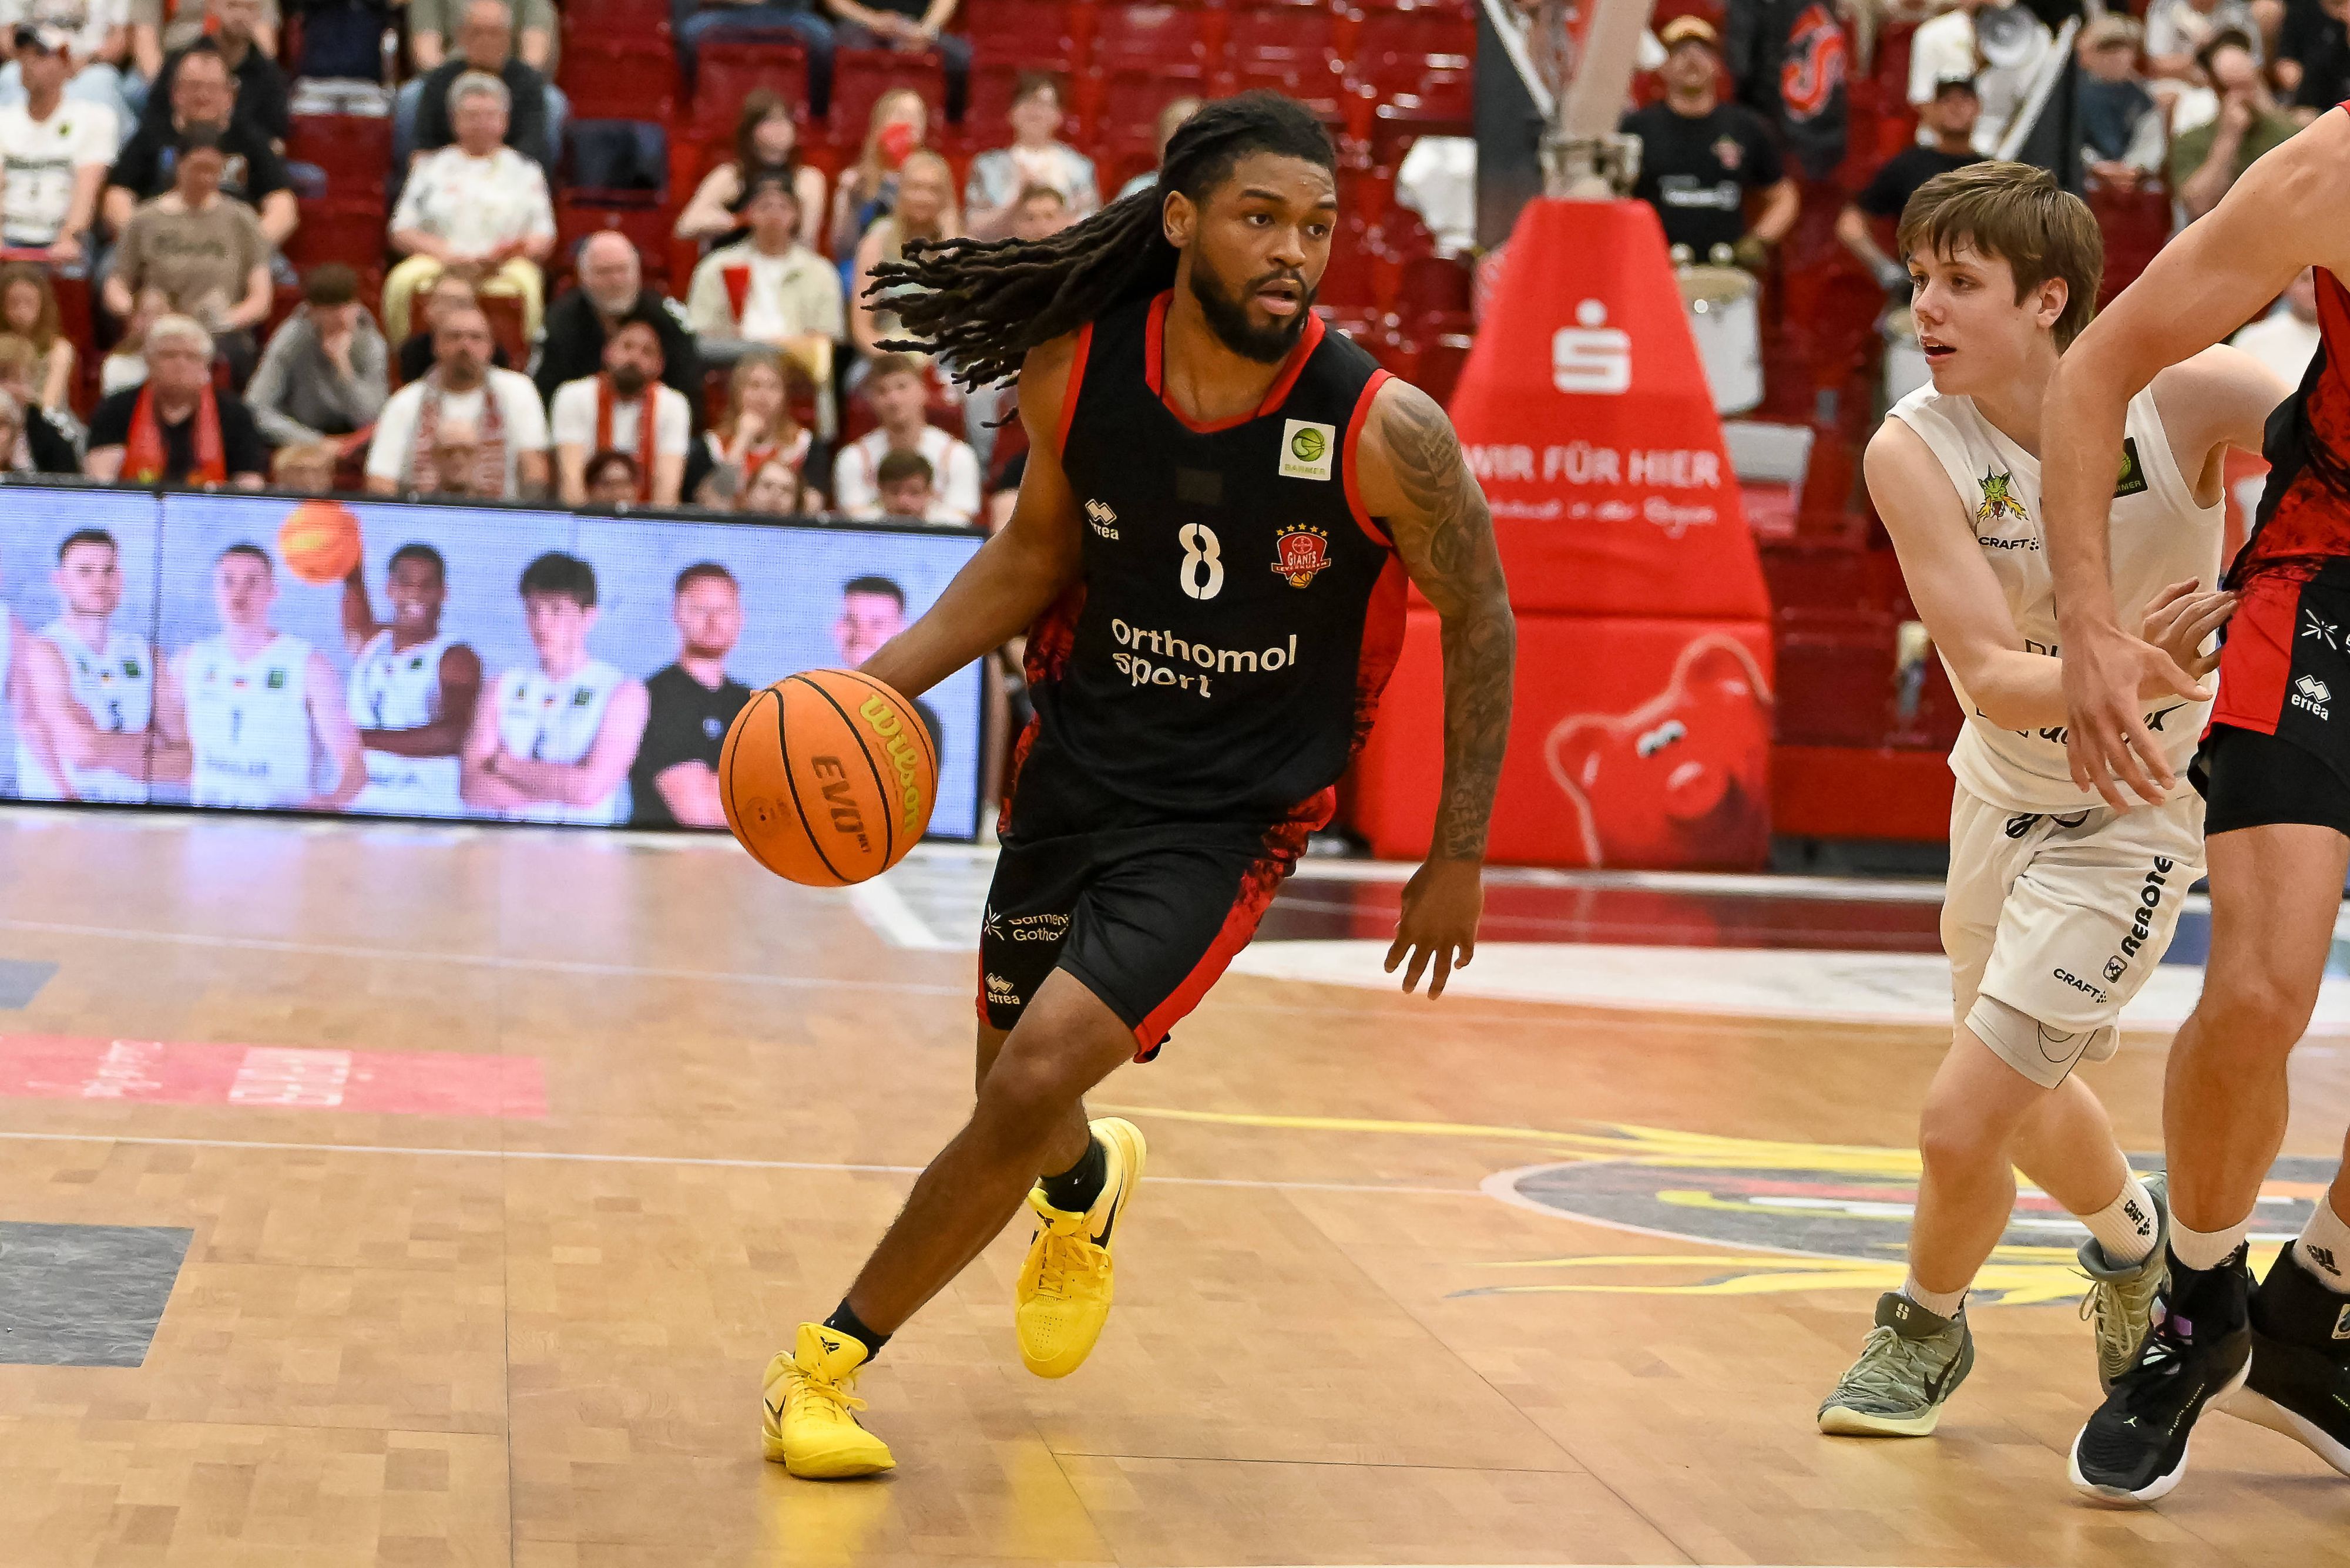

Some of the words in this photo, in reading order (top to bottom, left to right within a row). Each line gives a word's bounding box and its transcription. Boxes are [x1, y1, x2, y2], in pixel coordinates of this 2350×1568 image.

[1284, 464, 1325, 475] BARMER
[1543, 439, 1622, 485] FÜR
[1628, 448, 1720, 489] HIER
[1179, 523, 1224, 600] 8
[1287, 550, 1317, 566] GIANTS
[1978, 536, 2030, 550] CRAFT
[1112, 619, 1297, 670] Orthomol
[1112, 653, 1213, 698] sport
[2291, 694, 2329, 721] errea
[860, 694, 921, 833] Wilson
[811, 756, 865, 833] EVO
[2121, 855, 2174, 958] REBOTE
[988, 991, 1020, 1005] errea
[2053, 968, 2101, 998] CRAFT
[2124, 1199, 2144, 1225] CRAFT
